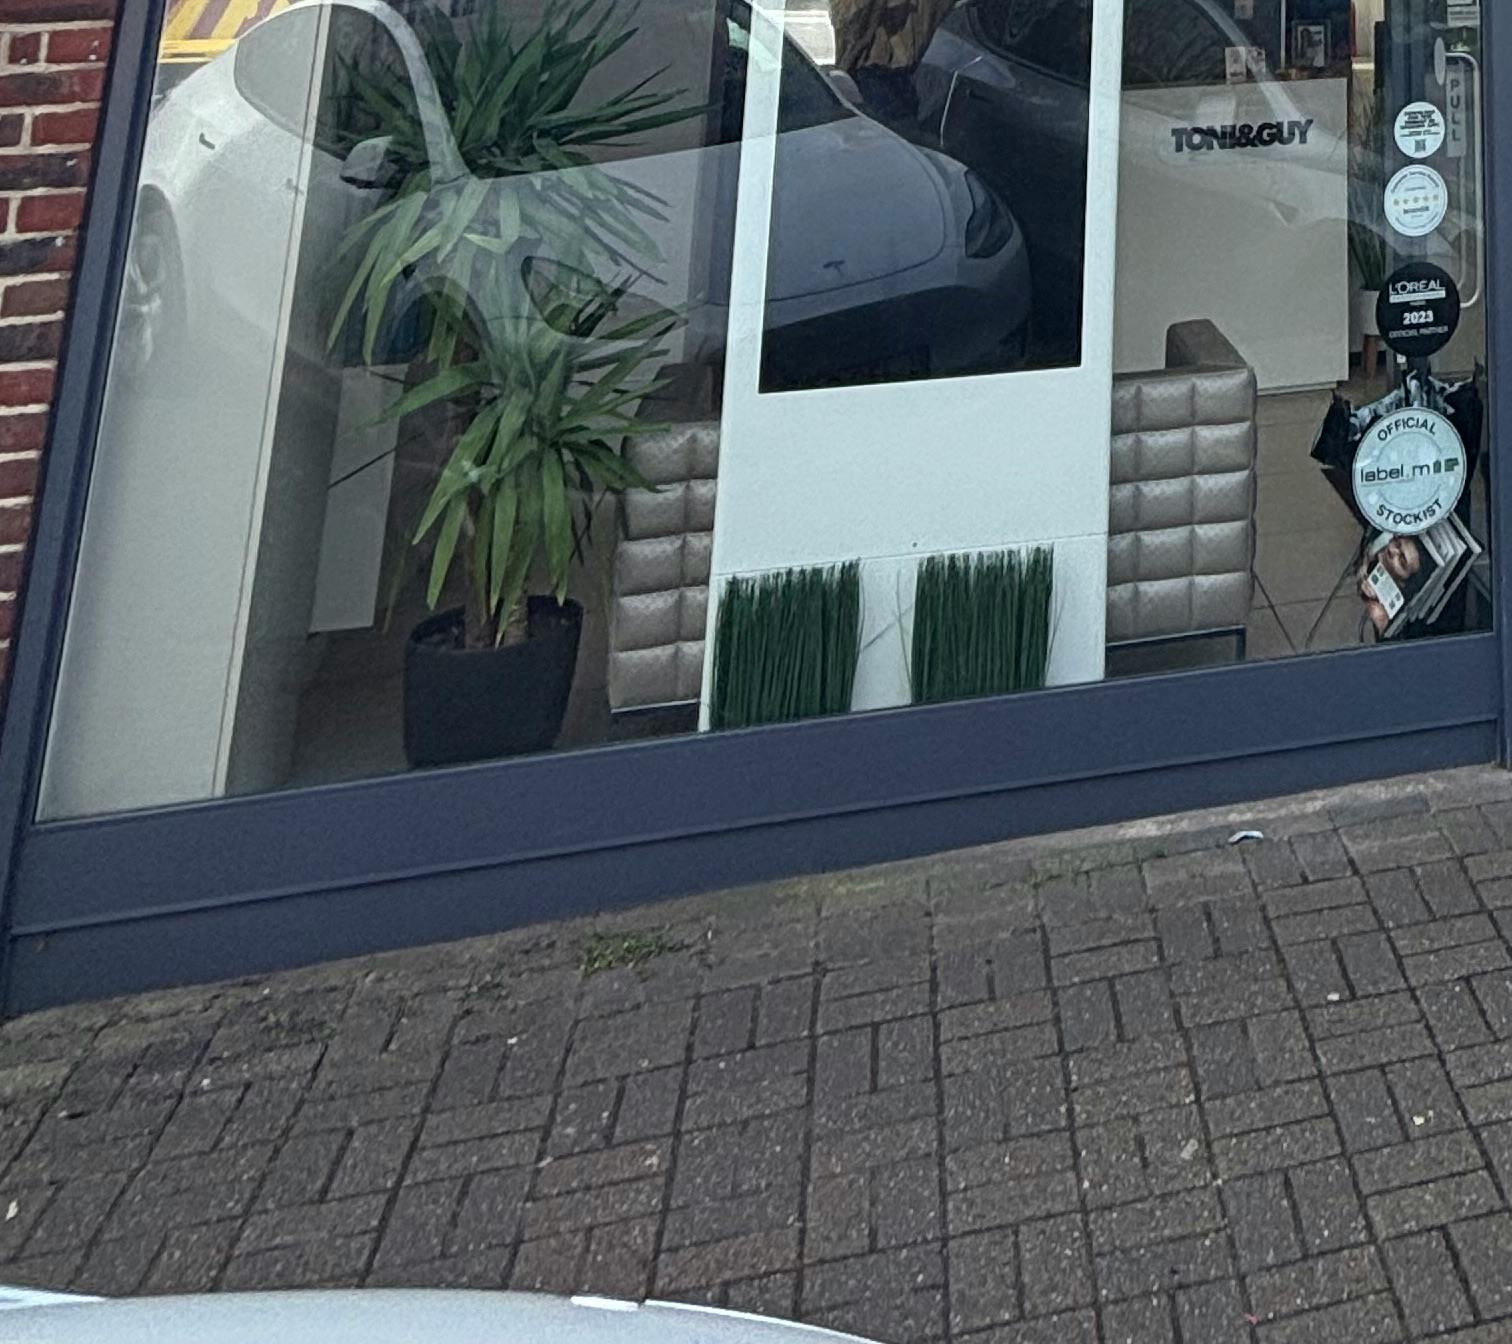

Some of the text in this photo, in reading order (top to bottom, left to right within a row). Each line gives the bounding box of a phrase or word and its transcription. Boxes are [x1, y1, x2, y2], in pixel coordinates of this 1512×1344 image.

[1450, 78, 1461, 142] PULL
[1171, 119, 1314, 153] TONI&GUY
[1403, 310, 1434, 325] 2023
[1377, 417, 1436, 441] OFFICIAL
[1360, 463, 1431, 483] label.m
[1376, 498, 1442, 525] STOCKIST
